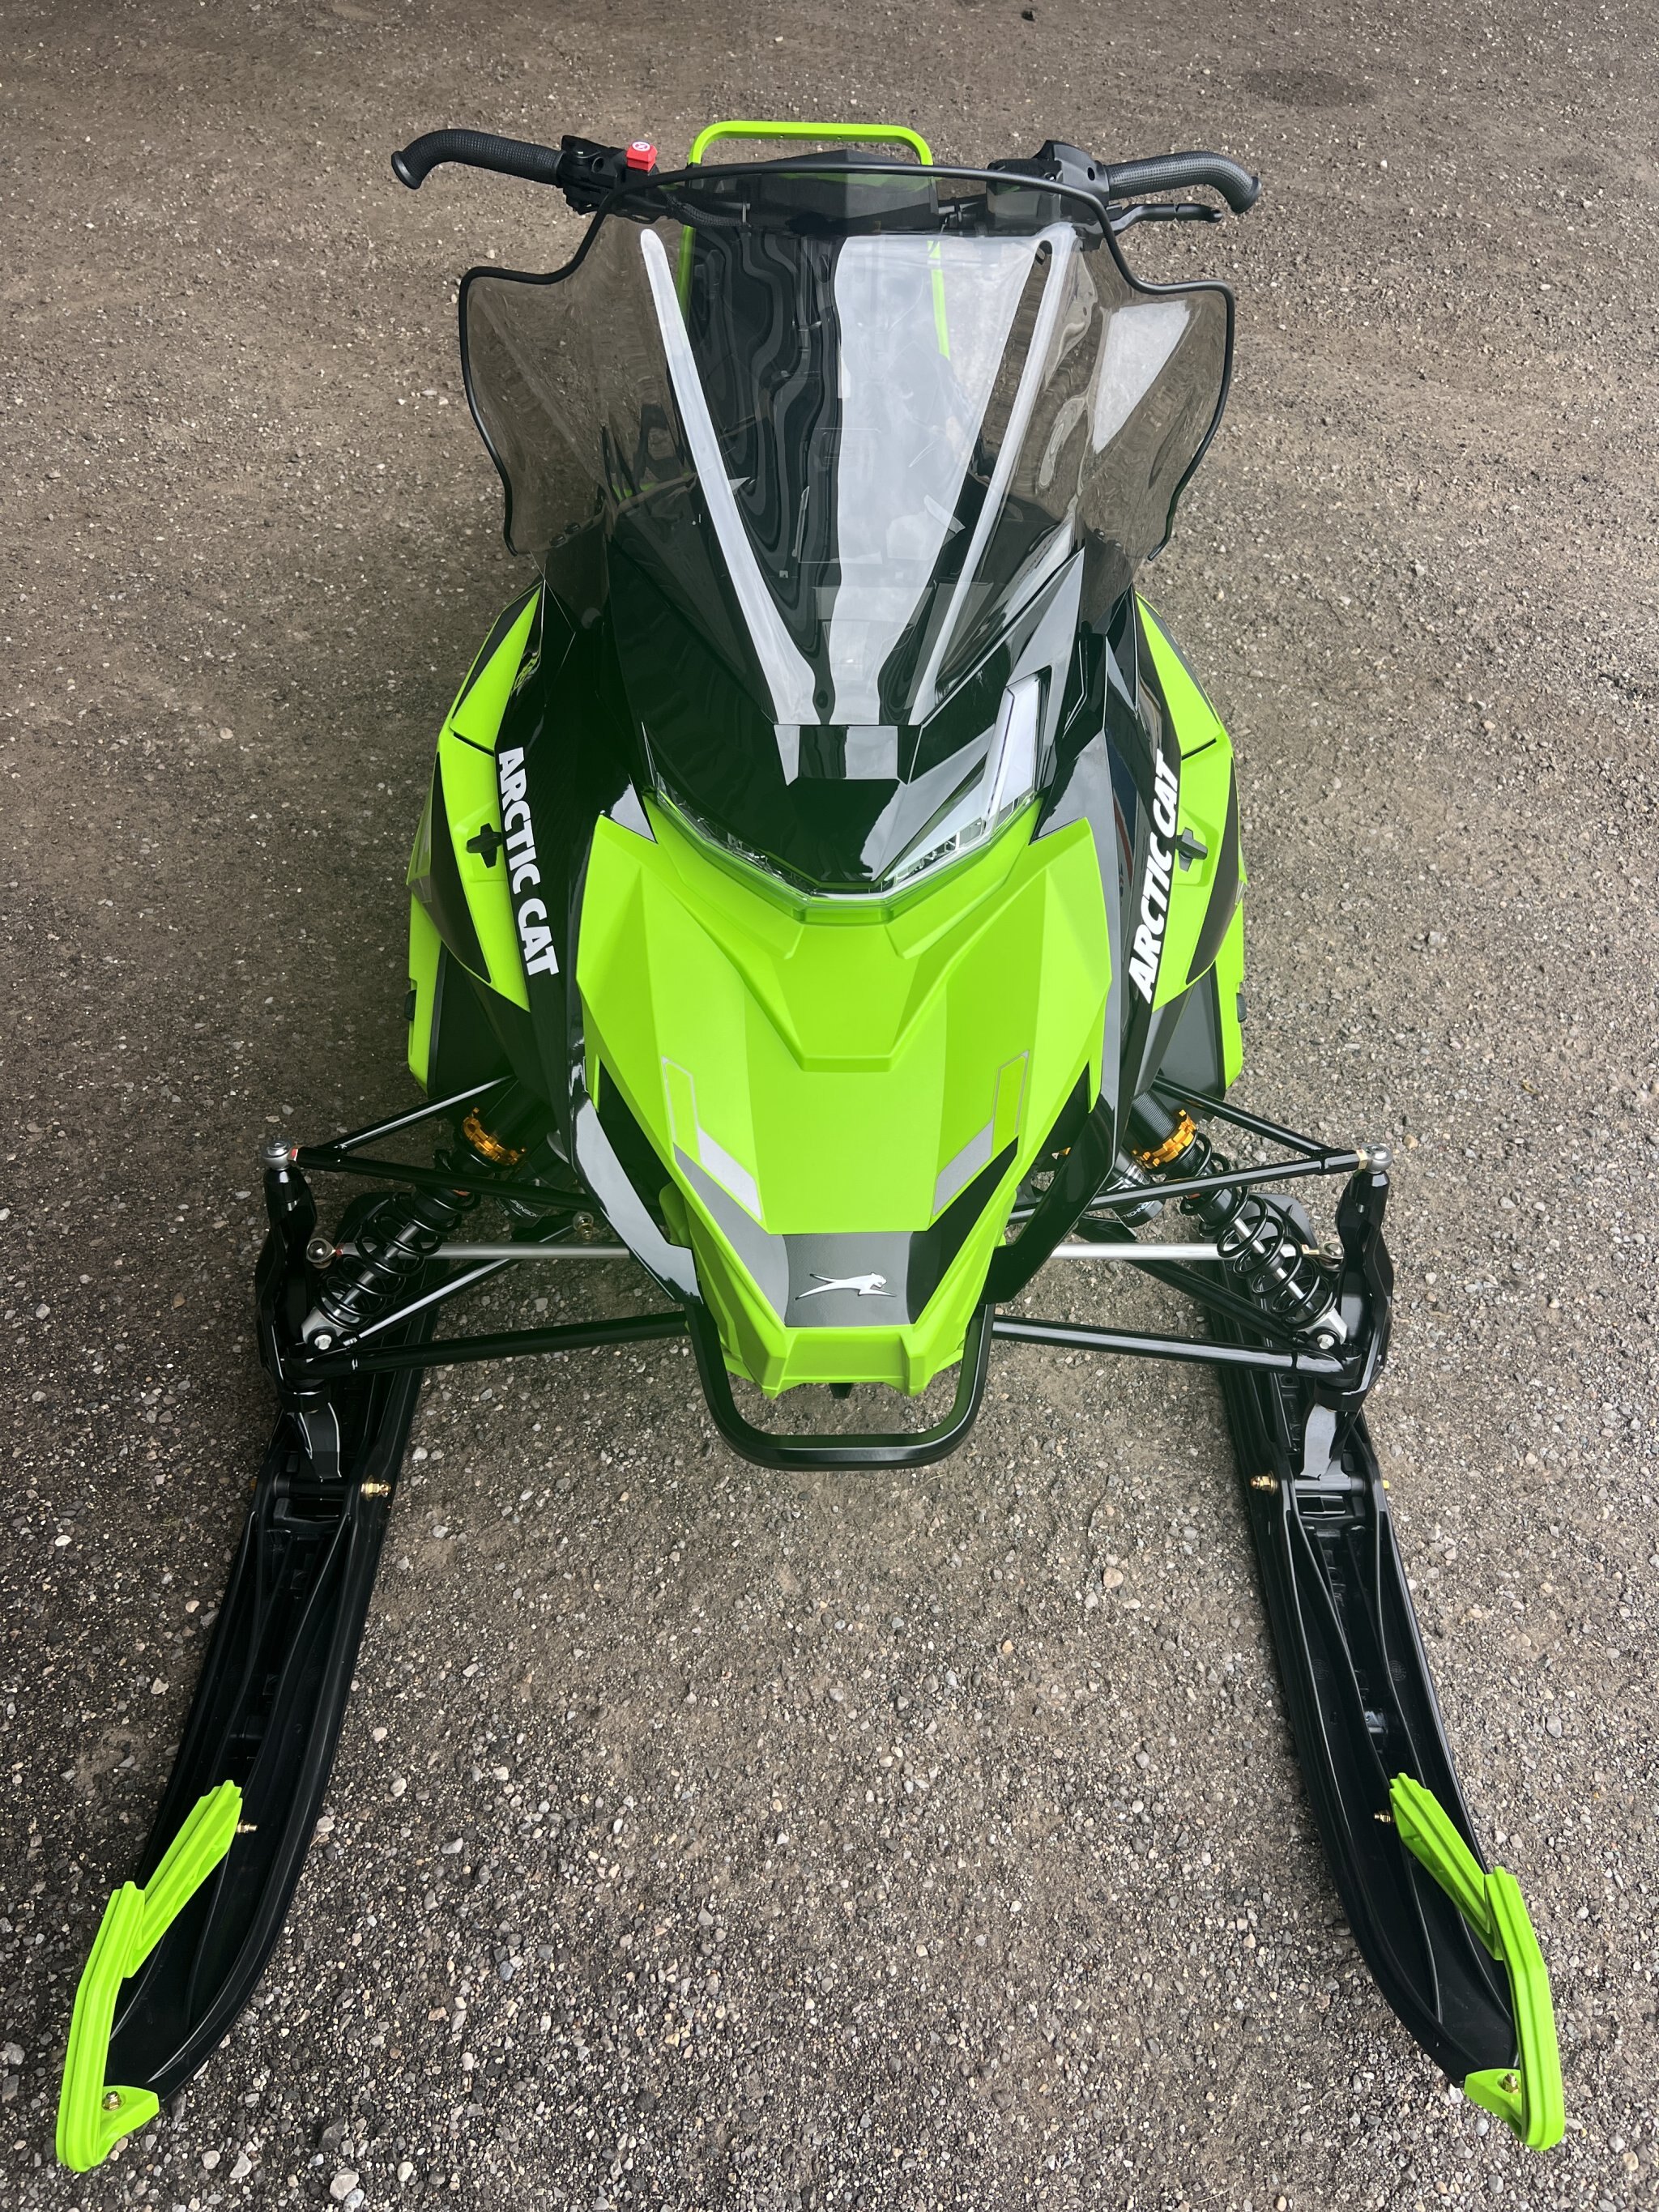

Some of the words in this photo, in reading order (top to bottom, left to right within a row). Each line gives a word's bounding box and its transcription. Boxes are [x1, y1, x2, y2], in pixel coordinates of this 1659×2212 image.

[498, 747, 541, 894] ARCTIC
[1128, 832, 1173, 1004] ARCTIC
[1153, 748, 1178, 838] CAT
[518, 897, 560, 975] CAT
